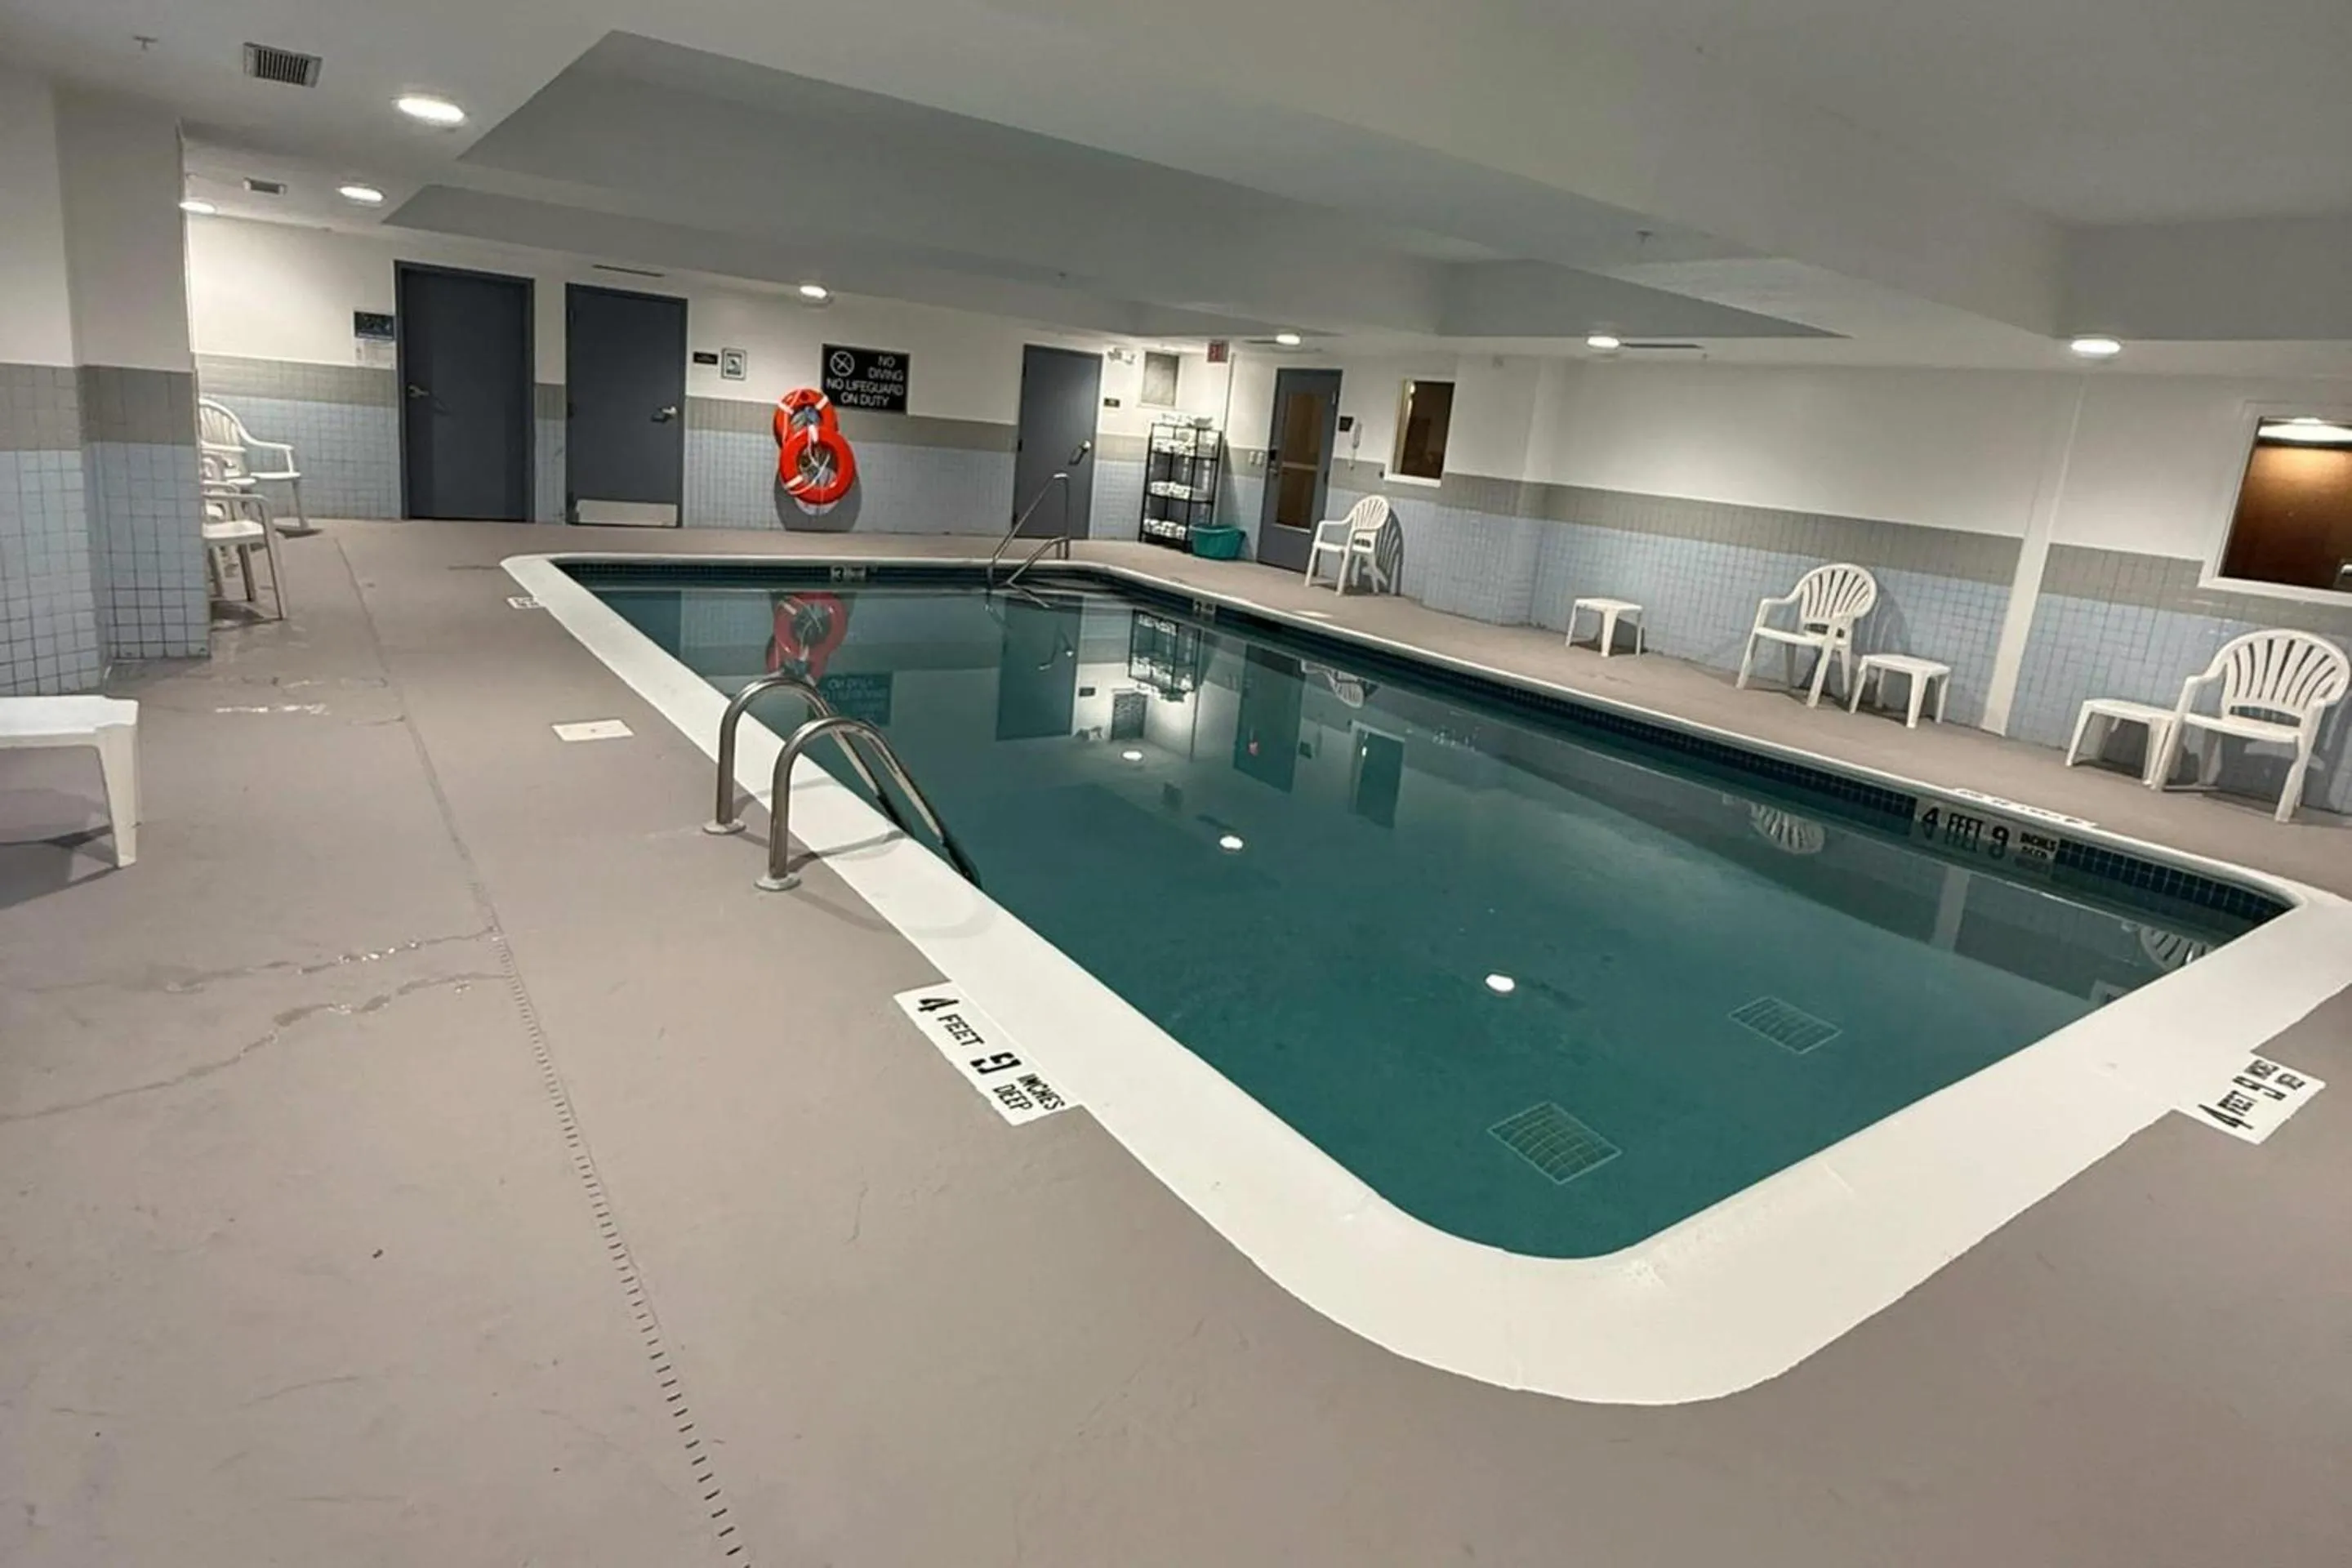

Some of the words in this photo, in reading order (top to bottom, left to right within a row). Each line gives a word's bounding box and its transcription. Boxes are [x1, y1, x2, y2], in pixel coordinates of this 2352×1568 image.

[868, 367, 903, 381] DIVING
[878, 355, 895, 368] NO
[826, 377, 844, 390] NO
[845, 379, 903, 396] LIFEGUARD
[840, 392, 858, 404] ON
[860, 394, 889, 407] DUTY
[1922, 806, 1940, 826] 4
[1947, 813, 1984, 835] FEET
[1992, 826, 2009, 847] 9
[917, 997, 960, 1012] 4
[937, 1013, 985, 1046] FEET
[970, 1052, 1022, 1075] 9
[992, 1084, 1034, 1110] DEEP
[1017, 1073, 1066, 1111] INCHES
[2232, 1075, 2287, 1101] 9
[2216, 1089, 2258, 1116] FEET
[2197, 1103, 2254, 1130] 4
